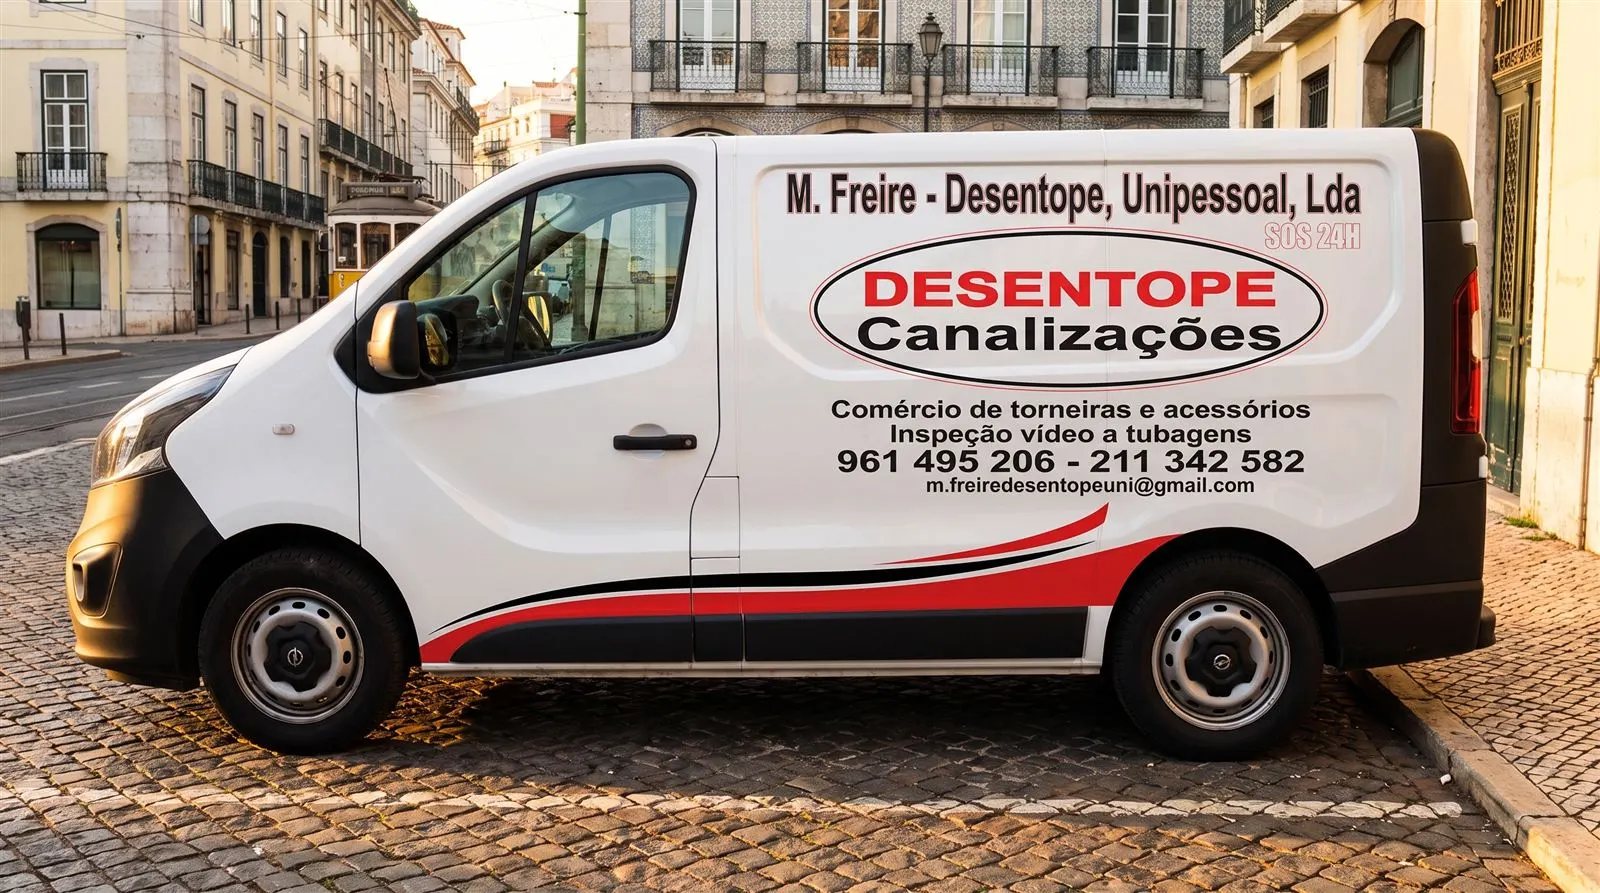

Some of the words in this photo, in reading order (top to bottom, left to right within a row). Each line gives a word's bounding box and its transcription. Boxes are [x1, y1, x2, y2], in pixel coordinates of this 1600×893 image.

[786, 172, 821, 214] M.
[830, 172, 917, 214] Freire
[945, 172, 1113, 224] Desentope,
[1122, 171, 1296, 224] Unipessoal,
[1306, 172, 1361, 214] Lda
[1264, 222, 1312, 250] SOS
[1316, 222, 1361, 250] 24H
[864, 270, 1276, 308] DESENTOPE
[857, 315, 1282, 360] Canalizações
[831, 400, 961, 419] Comércio
[970, 400, 1002, 419] de
[1011, 400, 1131, 419] torneiras
[1140, 405, 1155, 419] e
[1164, 400, 1311, 419] acessórios
[890, 424, 1012, 448] Inspeção
[1021, 424, 1094, 443] vídeo
[1103, 429, 1118, 443] a
[1126, 424, 1252, 448] tubagens
[837, 450, 898, 473] 961
[914, 450, 979, 473] 495
[991, 450, 1055, 473] 206
[1090, 450, 1149, 473] 211
[1164, 450, 1229, 473] 342
[1241, 450, 1305, 473] 582
[926, 477, 1255, 496] m.freiredesentopeuni@gmail.com
